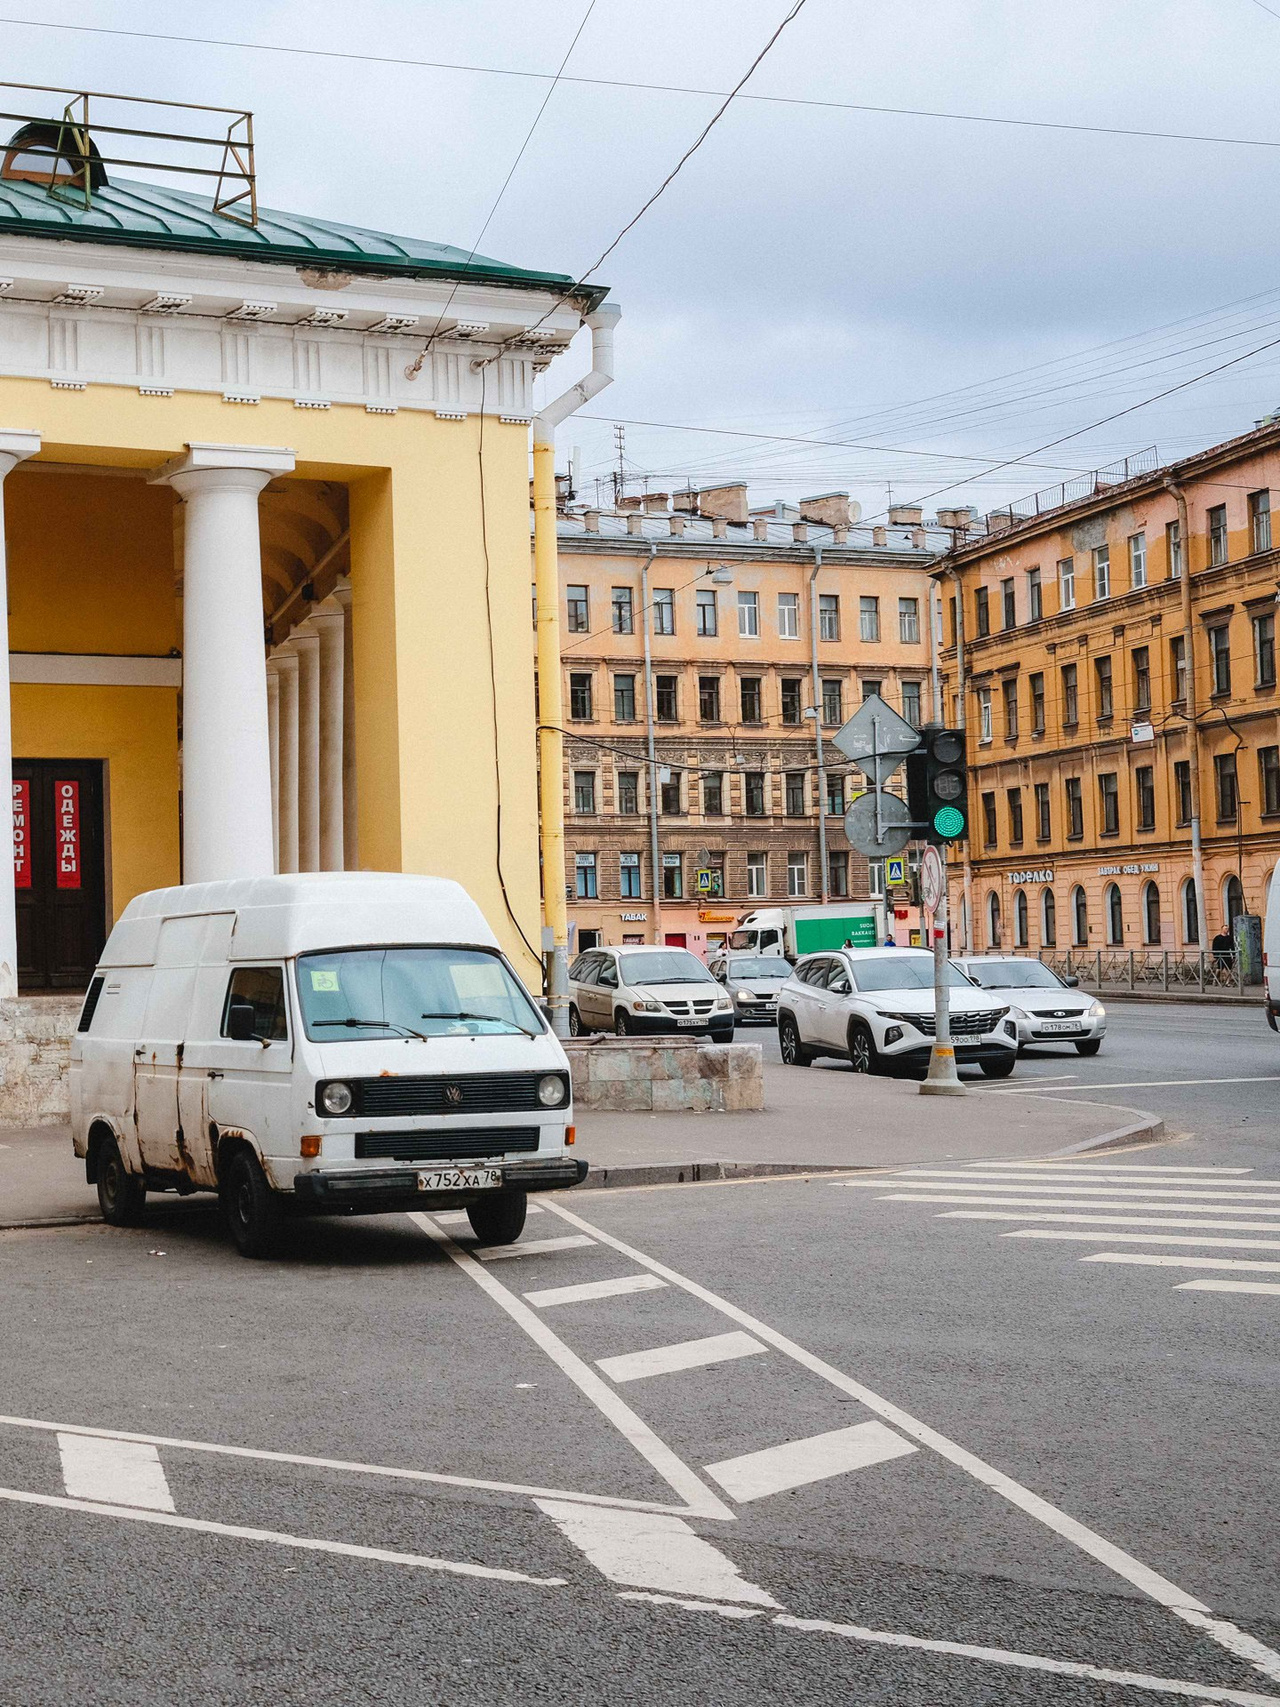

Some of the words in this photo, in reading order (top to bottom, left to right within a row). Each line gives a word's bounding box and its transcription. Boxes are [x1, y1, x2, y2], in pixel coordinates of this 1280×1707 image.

[13, 784, 25, 872] РЕМОНТ
[60, 785, 76, 872] ОДЕЖДЫ
[1122, 864, 1140, 875] ОБЕД
[621, 913, 648, 921] ТАБАК
